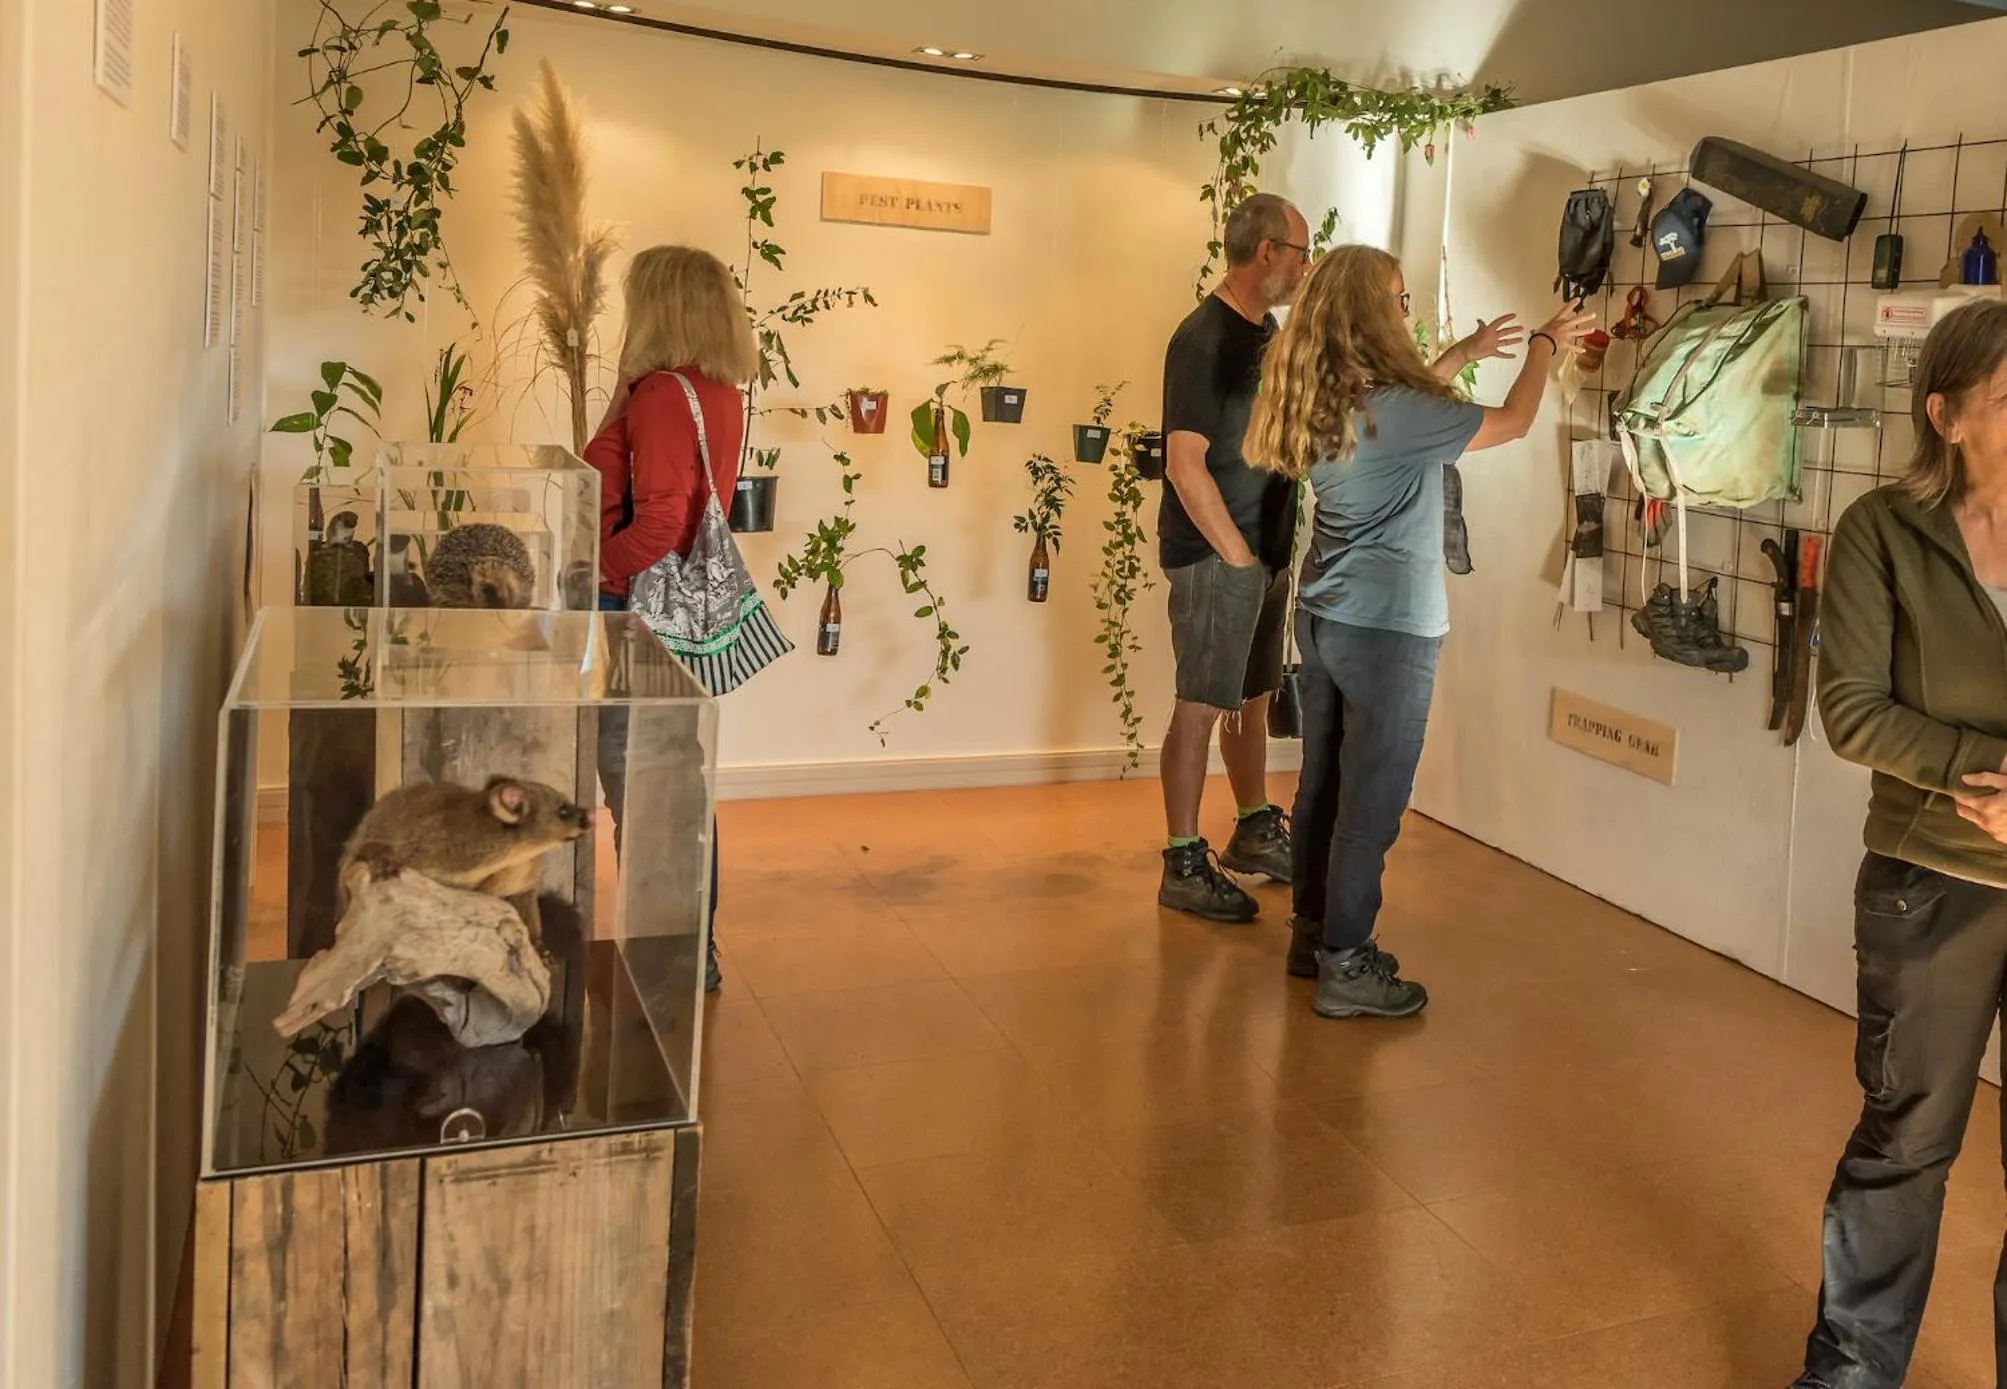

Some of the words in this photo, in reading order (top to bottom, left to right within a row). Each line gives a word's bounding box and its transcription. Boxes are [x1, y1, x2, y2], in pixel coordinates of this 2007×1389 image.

[858, 194, 897, 208] PEST
[905, 198, 961, 214] PLANTS
[1567, 713, 1623, 744] TRAPPING
[1627, 735, 1660, 758] GEAR
